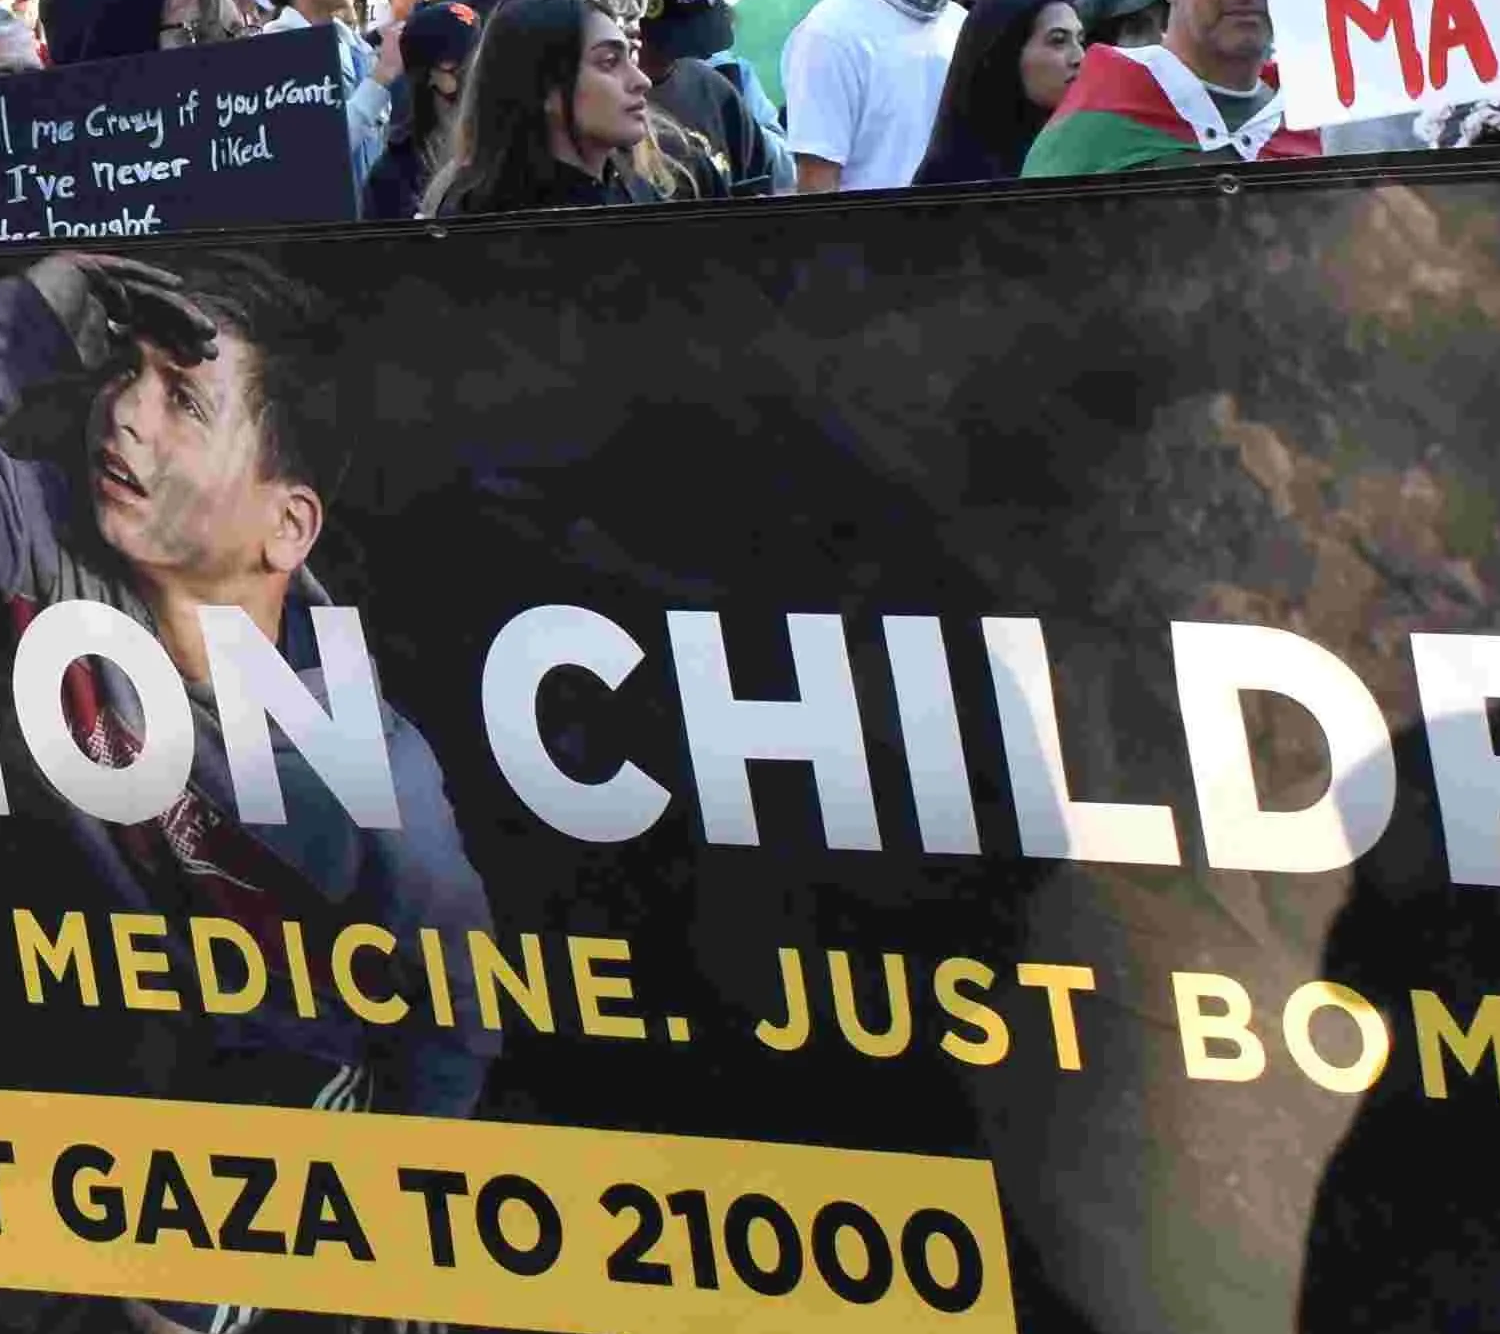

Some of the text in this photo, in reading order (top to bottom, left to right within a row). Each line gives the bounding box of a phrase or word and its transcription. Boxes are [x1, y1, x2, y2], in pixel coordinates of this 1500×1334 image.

[6, 163, 75, 204] I've
[92, 156, 191, 193] never
[209, 125, 273, 172] liked
[31, 113, 76, 150] me
[177, 89, 200, 127] if
[215, 91, 259, 128] you
[12, 909, 691, 1043] MEDICINE.
[754, 946, 1097, 1073] JUST
[50, 1144, 376, 1263] GAZA
[396, 1169, 565, 1277] TO
[599, 1180, 986, 1315] 21000
